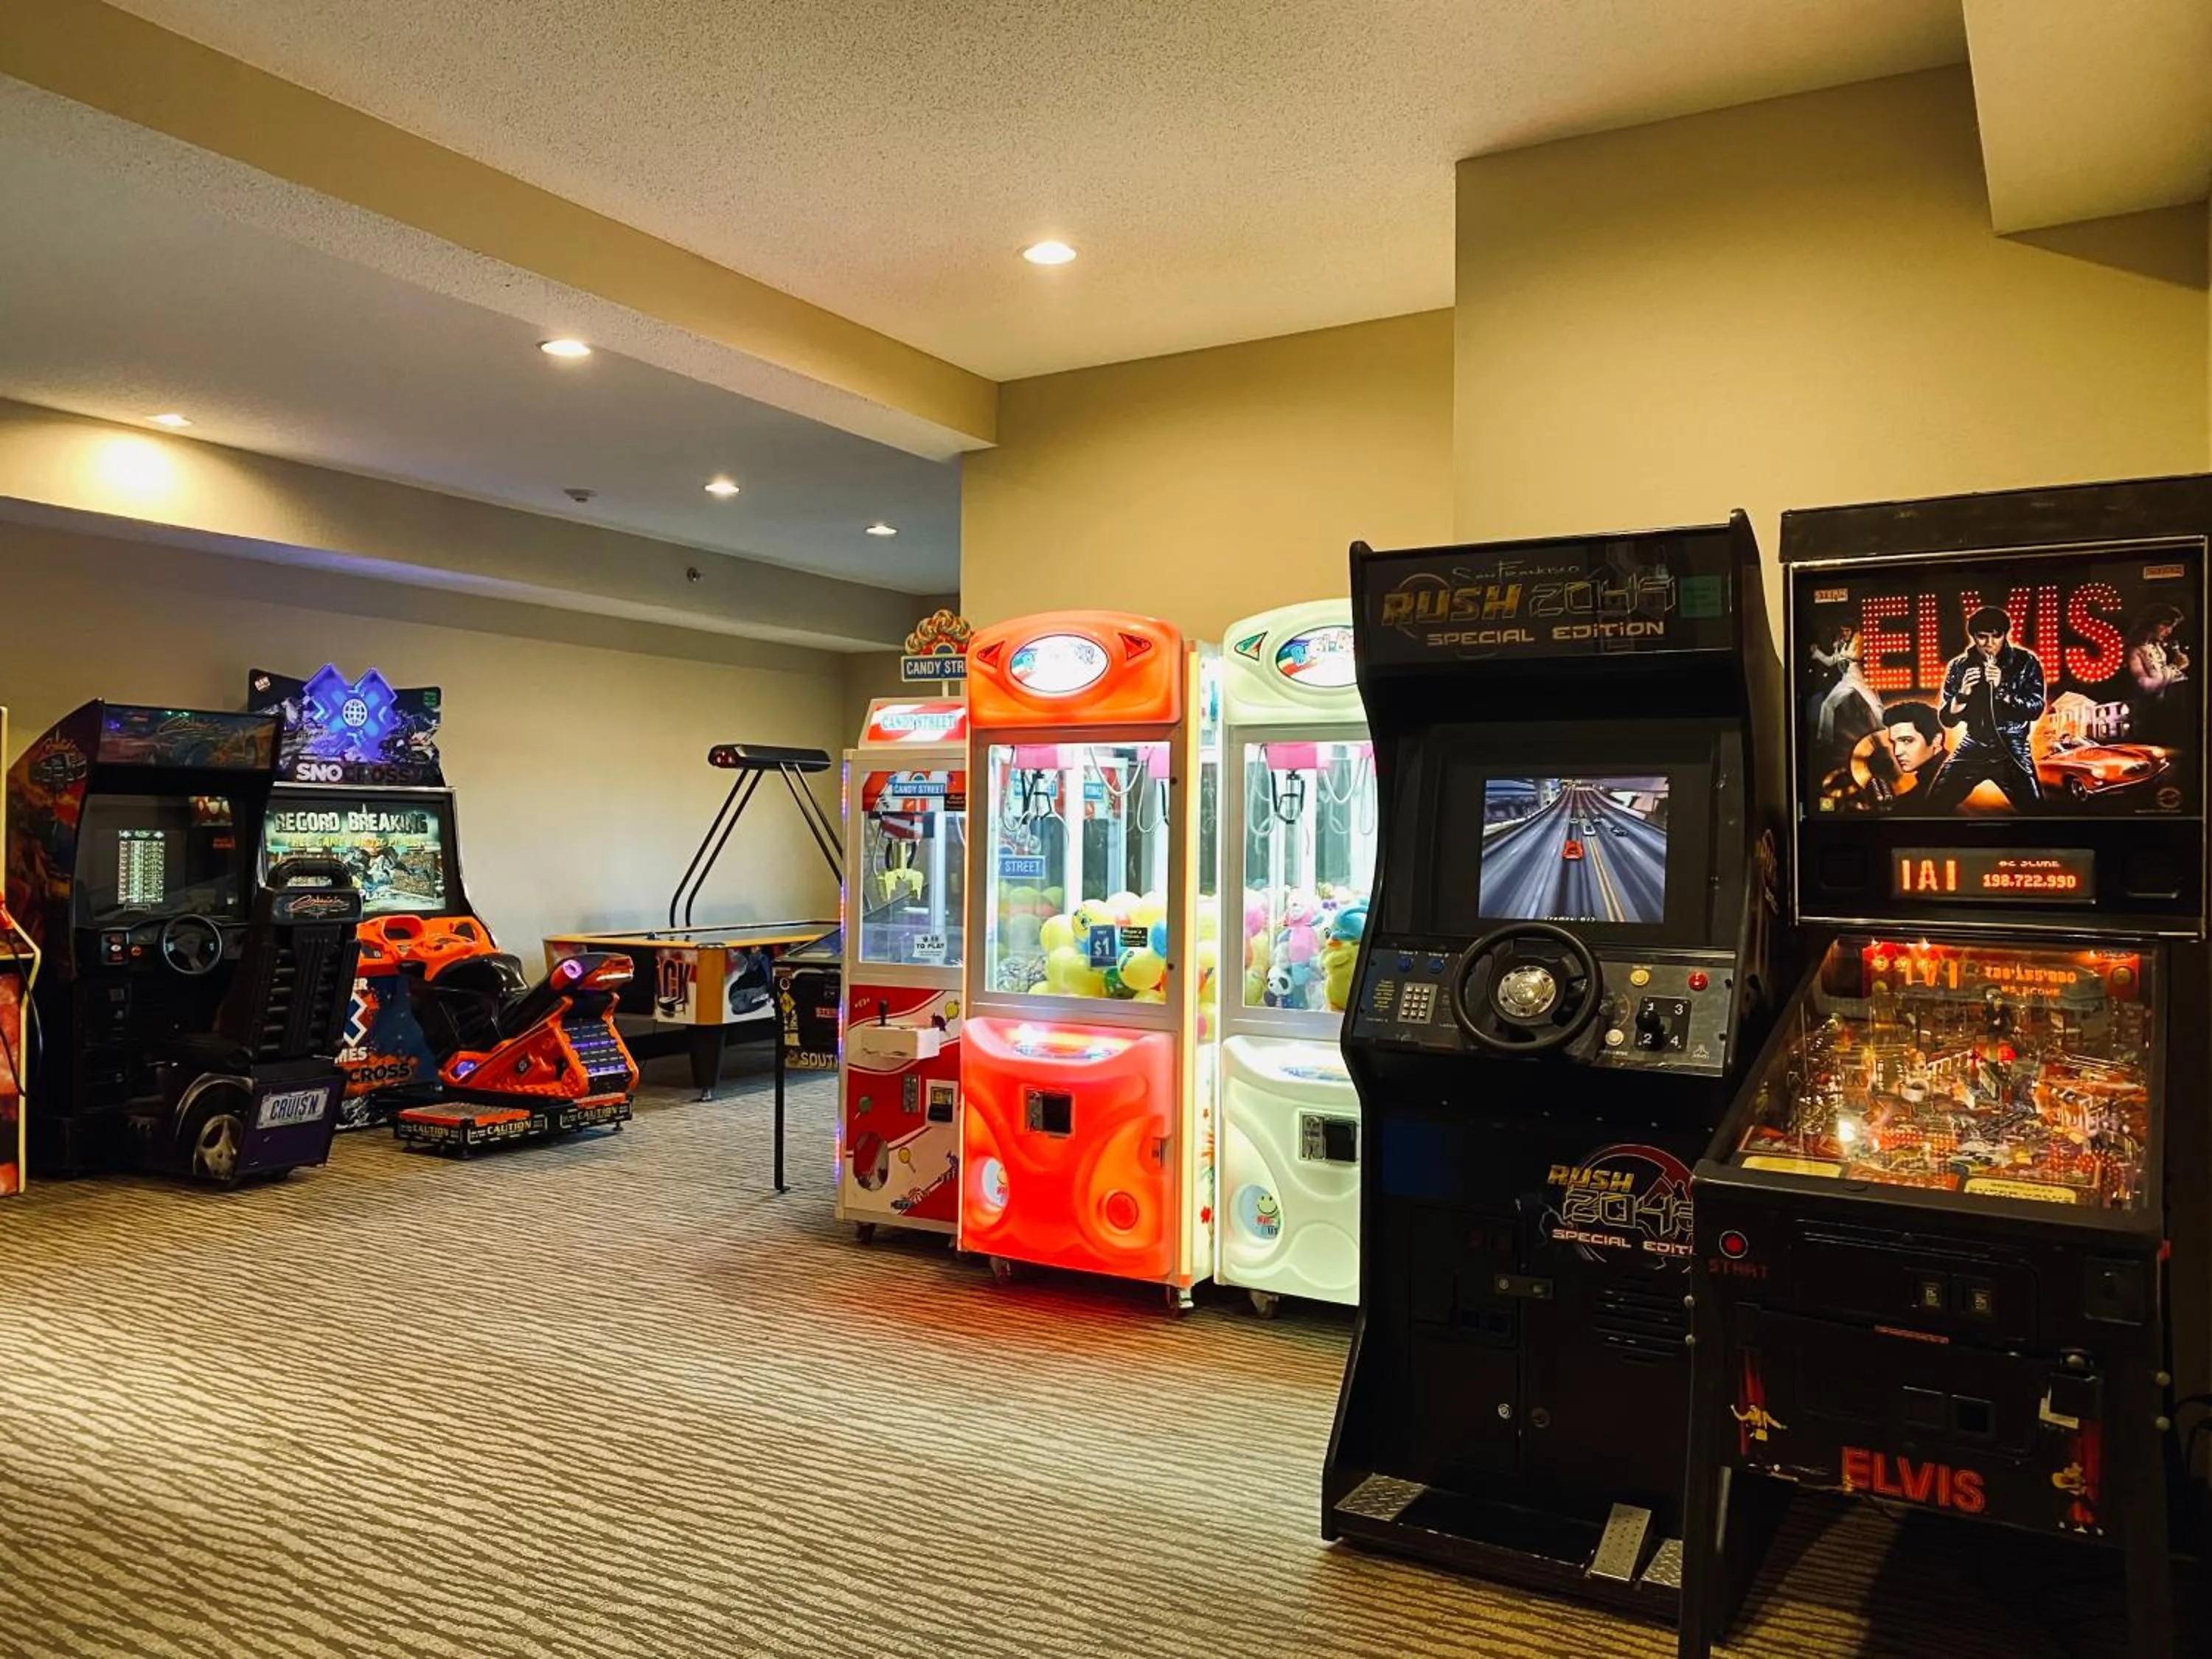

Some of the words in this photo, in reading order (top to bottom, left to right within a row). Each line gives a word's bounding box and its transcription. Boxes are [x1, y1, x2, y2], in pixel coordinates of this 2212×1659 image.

[1381, 583, 1522, 627] RUSH
[1427, 629, 1534, 647] SPECIAL
[906, 661, 942, 675] CANDY
[945, 661, 967, 674] STR
[881, 714, 913, 728] CANDY
[916, 714, 956, 728] STREET
[894, 784, 917, 795] CANDY
[918, 783, 944, 794] STREET
[274, 812, 341, 832] RECORD
[347, 811, 428, 833] BREAKING
[1005, 860, 1040, 873] STREET
[1093, 937, 1110, 959] $1
[1674, 1004, 1684, 1015] 3
[1643, 1033, 1652, 1044] 2
[1670, 1035, 1680, 1046] 4
[577, 1105, 619, 1120] CAUTION
[412, 1124, 449, 1136] CAUTION
[487, 1120, 532, 1135] CAUTION
[1548, 1164, 1635, 1192] RUSH
[1552, 1228, 1632, 1248] SPECIAL
[1708, 1258, 1769, 1279] START
[1842, 1445, 1986, 1513] ELVIS
